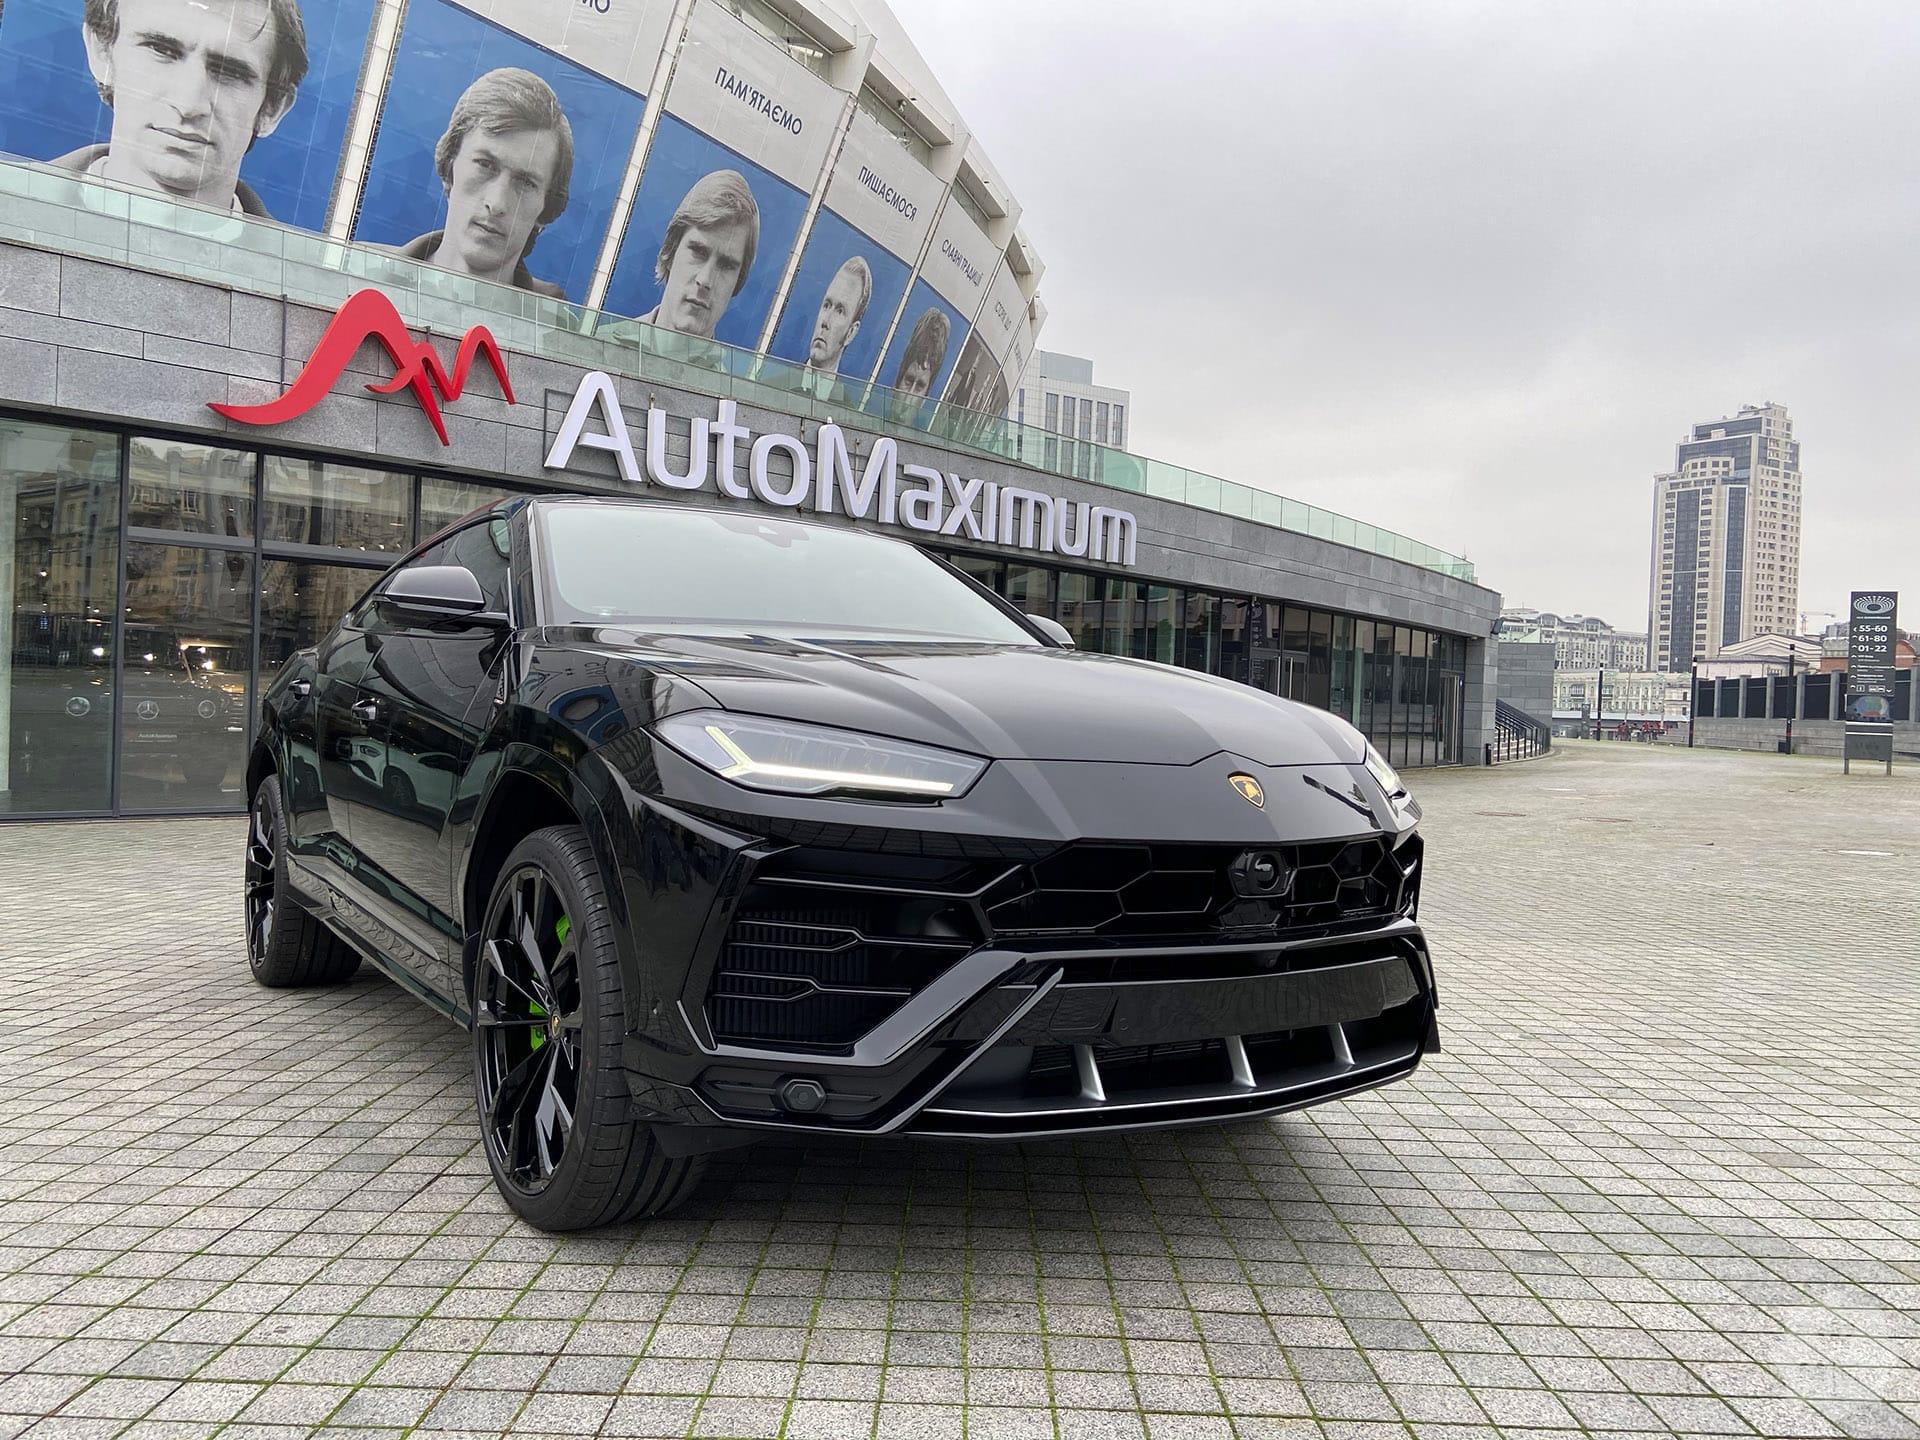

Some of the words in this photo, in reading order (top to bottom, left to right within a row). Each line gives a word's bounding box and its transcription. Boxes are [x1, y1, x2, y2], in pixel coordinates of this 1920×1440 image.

[714, 67, 803, 135] ПАМ'ЯТАЄМО
[858, 165, 918, 222] ПИШАЄМОСЯ
[543, 370, 1138, 567] AutoMaximum
[1858, 644, 1887, 652] 01-22
[1859, 624, 1888, 632] 55-60
